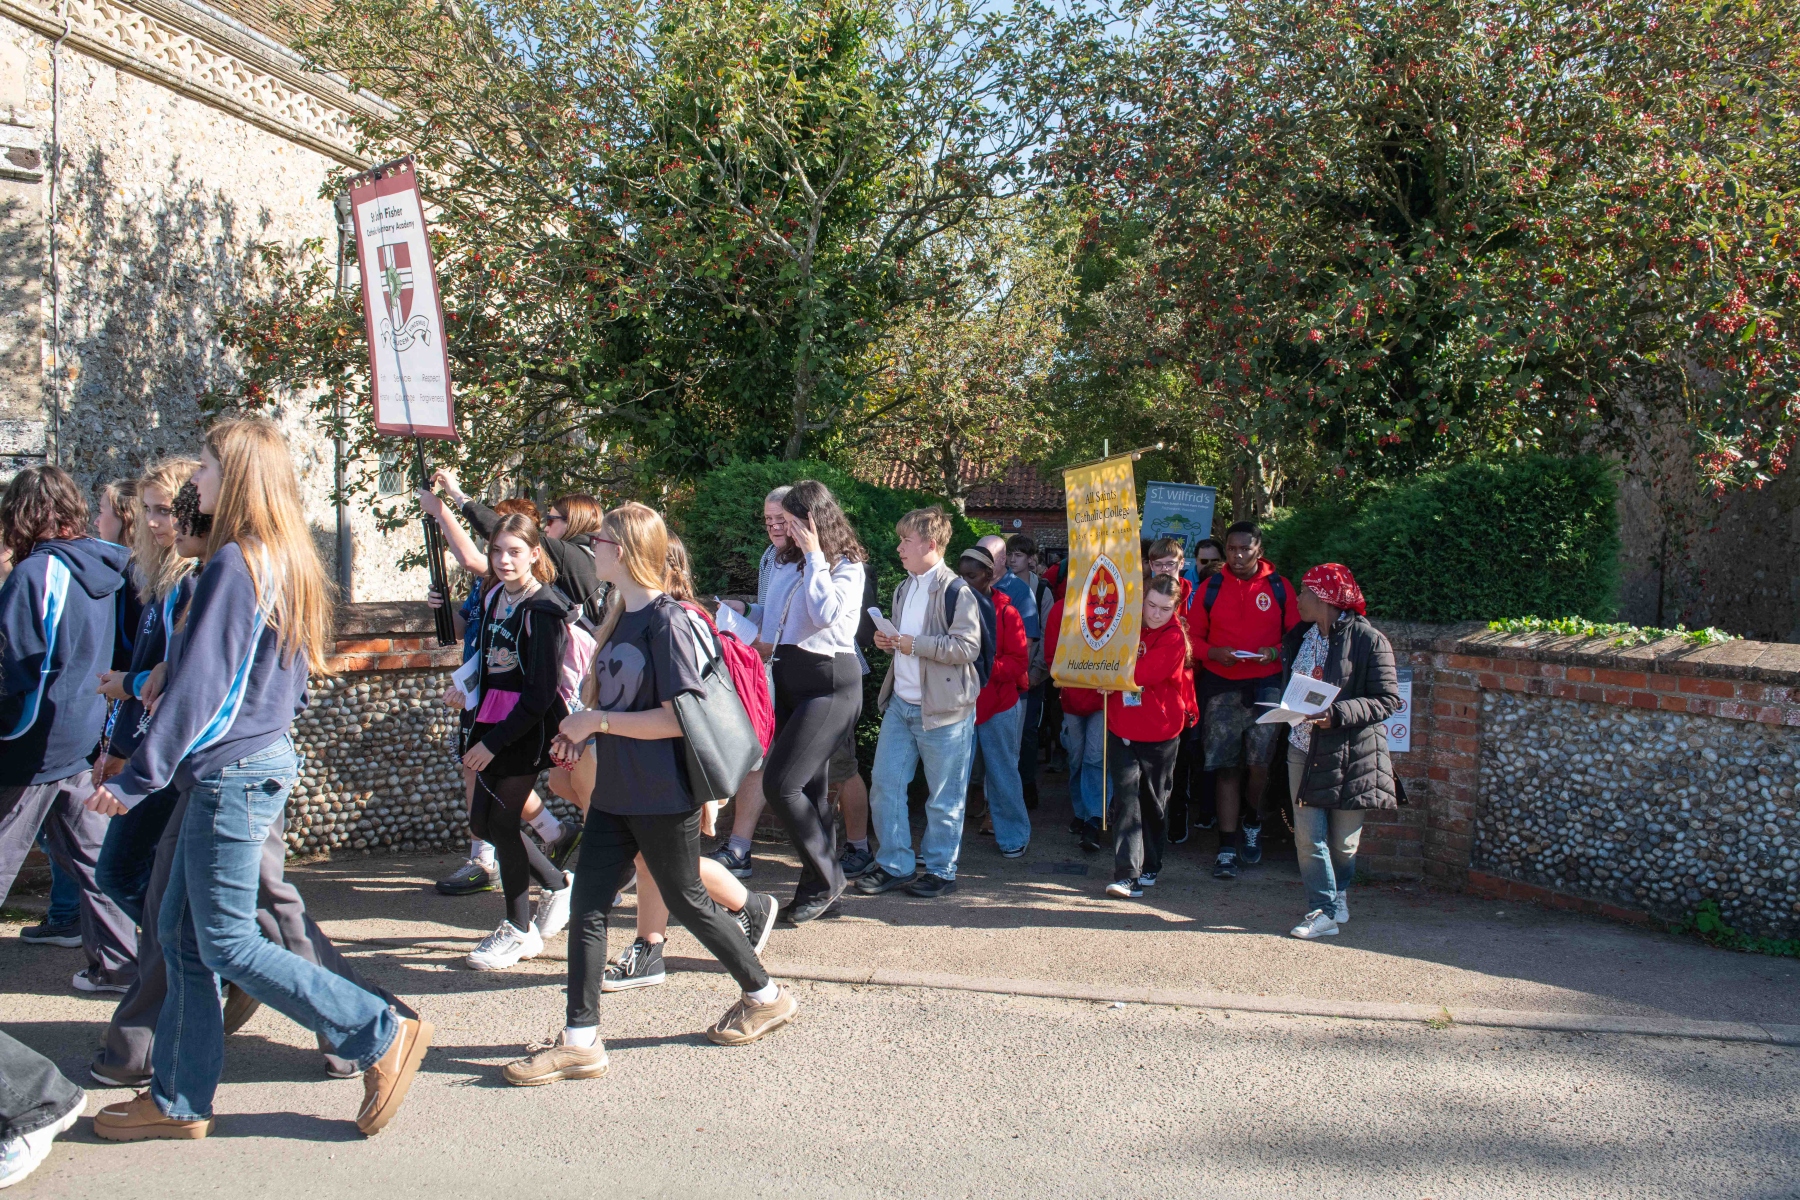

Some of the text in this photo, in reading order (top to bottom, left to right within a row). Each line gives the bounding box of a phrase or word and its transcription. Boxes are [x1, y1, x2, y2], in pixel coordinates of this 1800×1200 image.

[384, 205, 403, 218] Fisher
[396, 219, 414, 229] Academy
[393, 336, 409, 346] UCEM
[1085, 490, 1117, 504] All Saints
[1166, 490, 1210, 504] Wilfrid's
[1074, 505, 1130, 524] Catholic College
[1103, 558, 1120, 580] SAINTS
[1110, 606, 1123, 632] LEARN
[1067, 659, 1121, 671] Huddersfield
